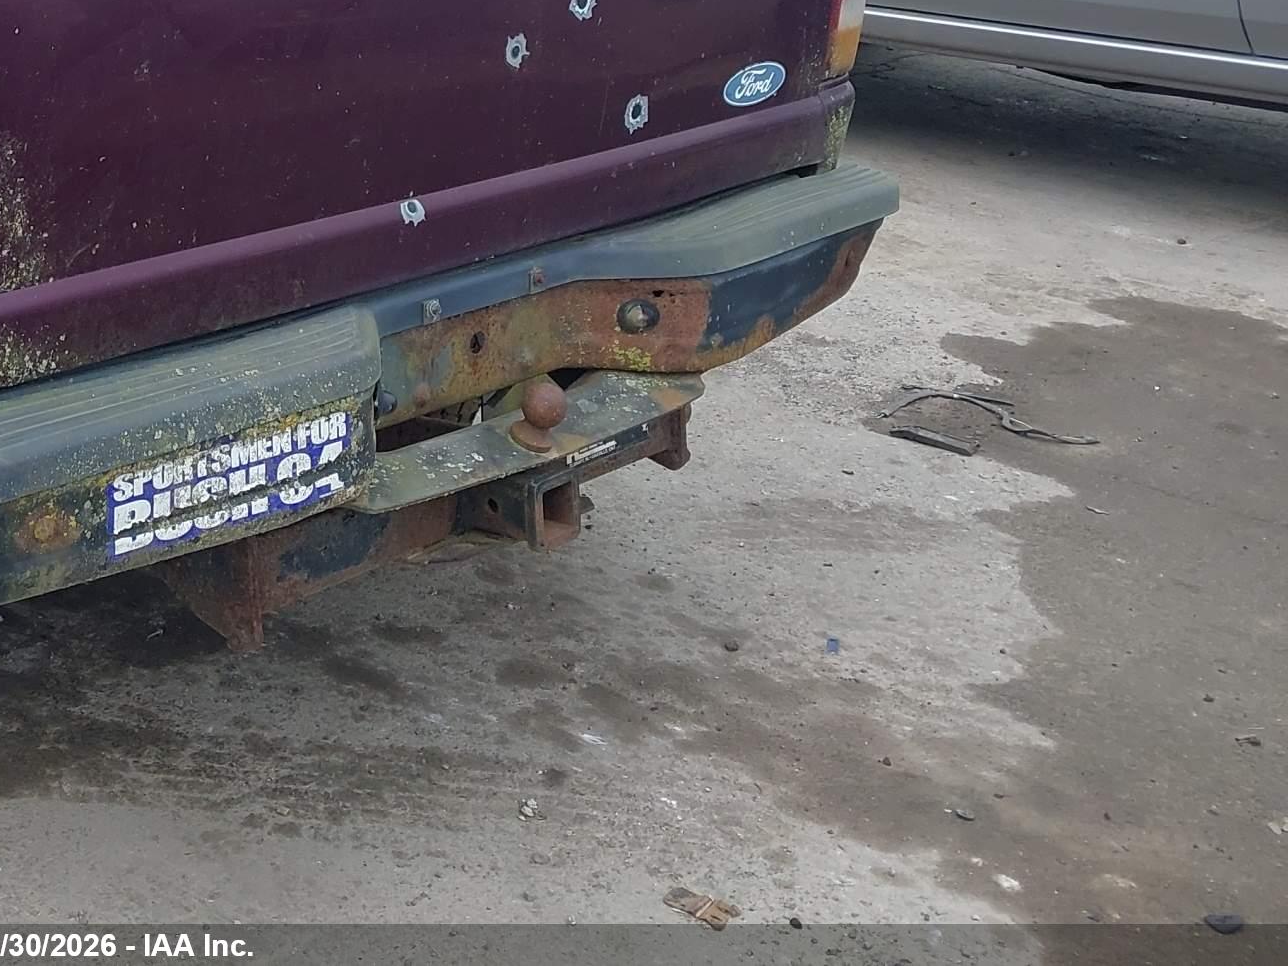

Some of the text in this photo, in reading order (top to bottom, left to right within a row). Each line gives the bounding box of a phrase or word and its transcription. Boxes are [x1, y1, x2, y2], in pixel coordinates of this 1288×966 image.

[732, 66, 776, 100] Ford
[113, 412, 347, 502] SPORTSMEN FOR
